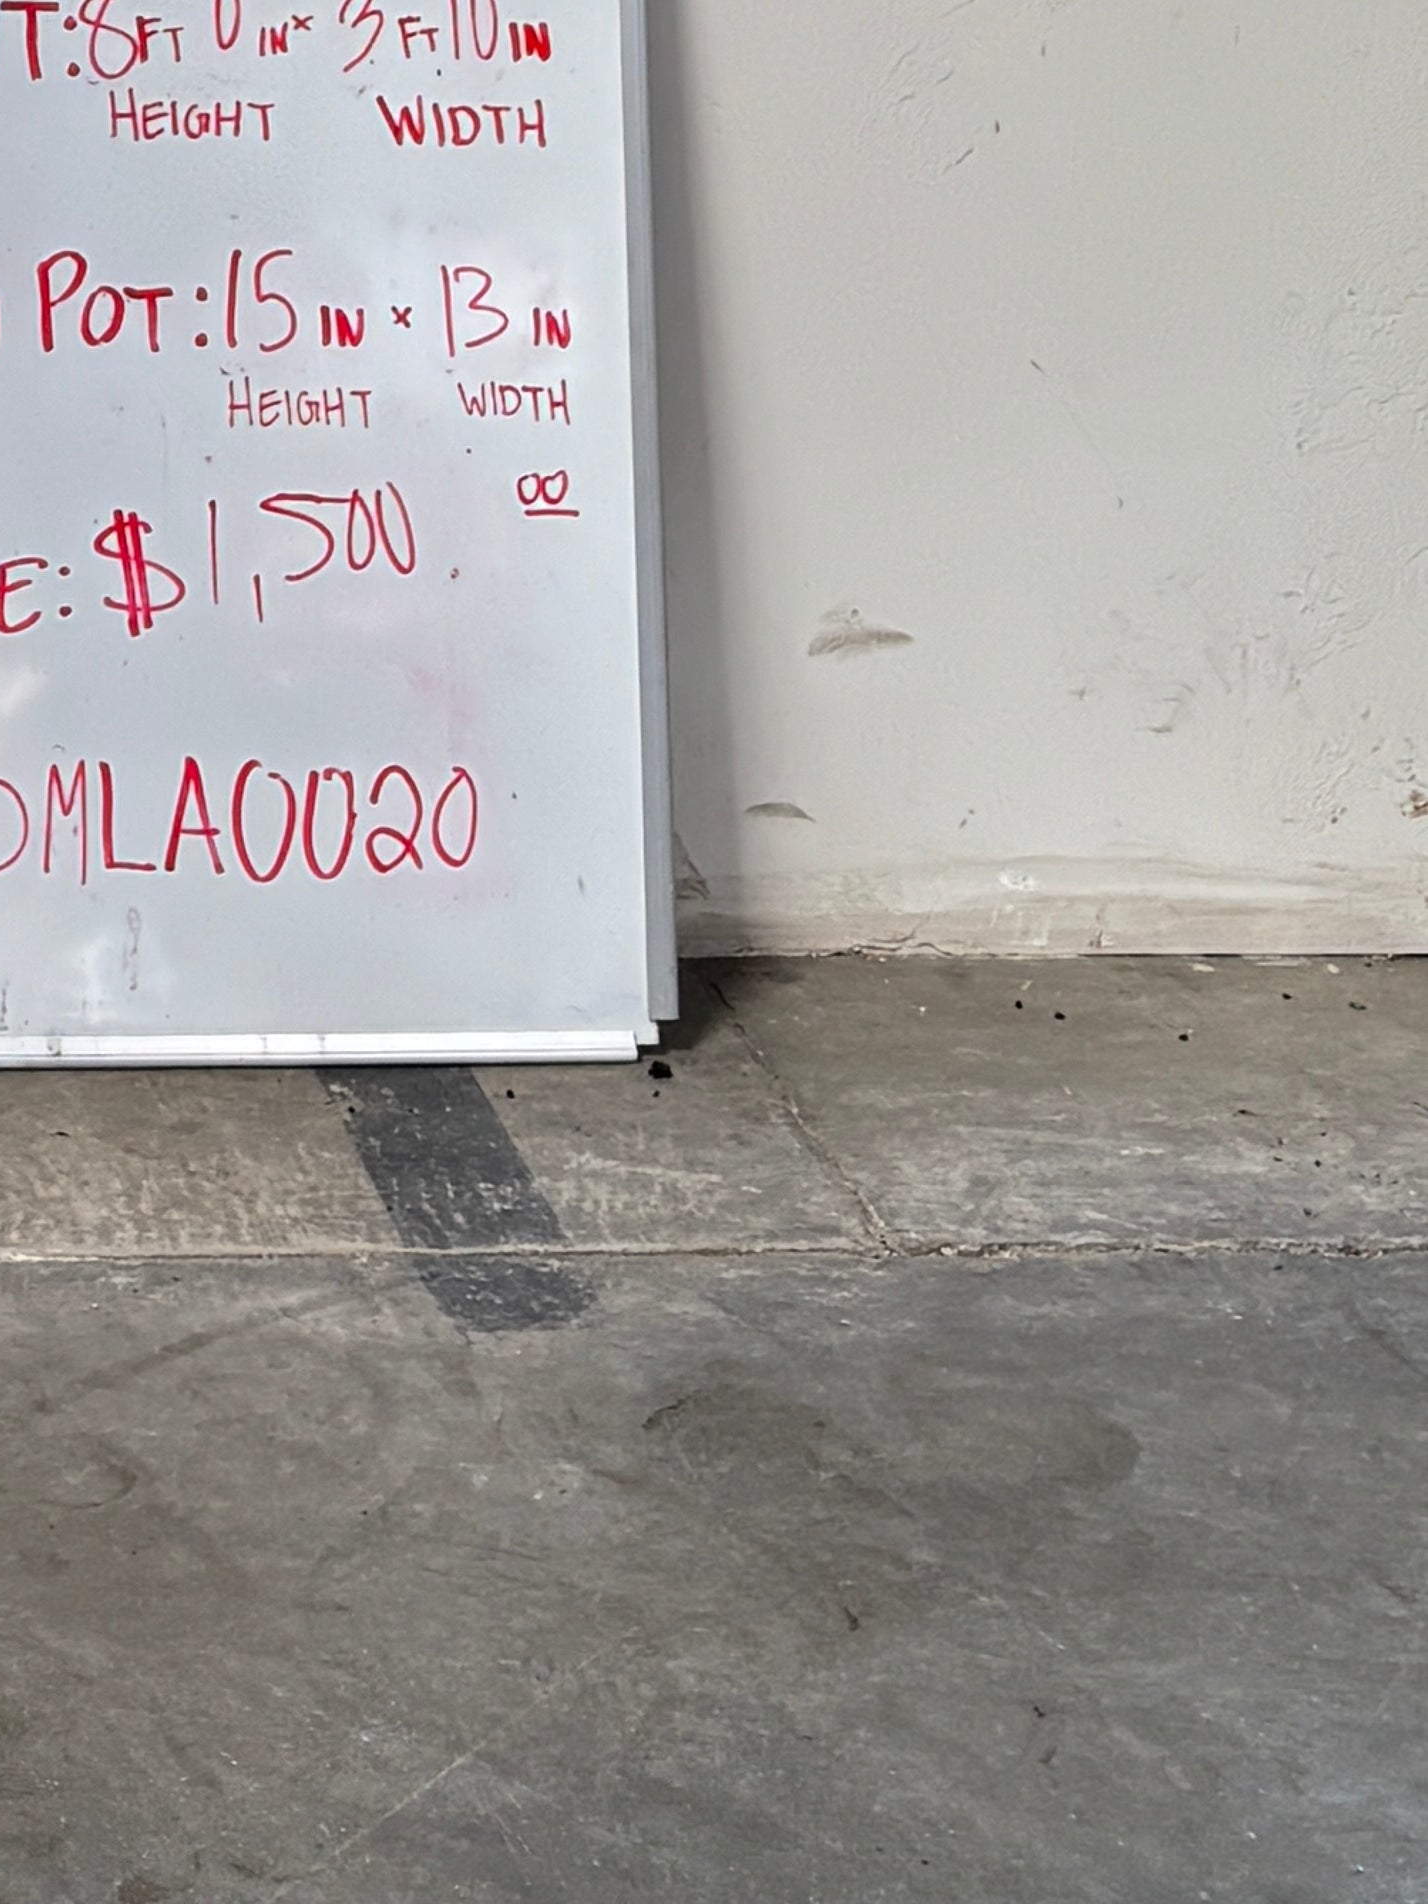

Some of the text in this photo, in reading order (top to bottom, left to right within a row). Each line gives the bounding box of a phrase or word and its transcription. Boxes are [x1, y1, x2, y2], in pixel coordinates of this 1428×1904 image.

[108, 87, 547, 148] HEIGHT WIDTH
[35, 249, 209, 354] POT:
[227, 376, 572, 429] HEIGHT WIDTH
